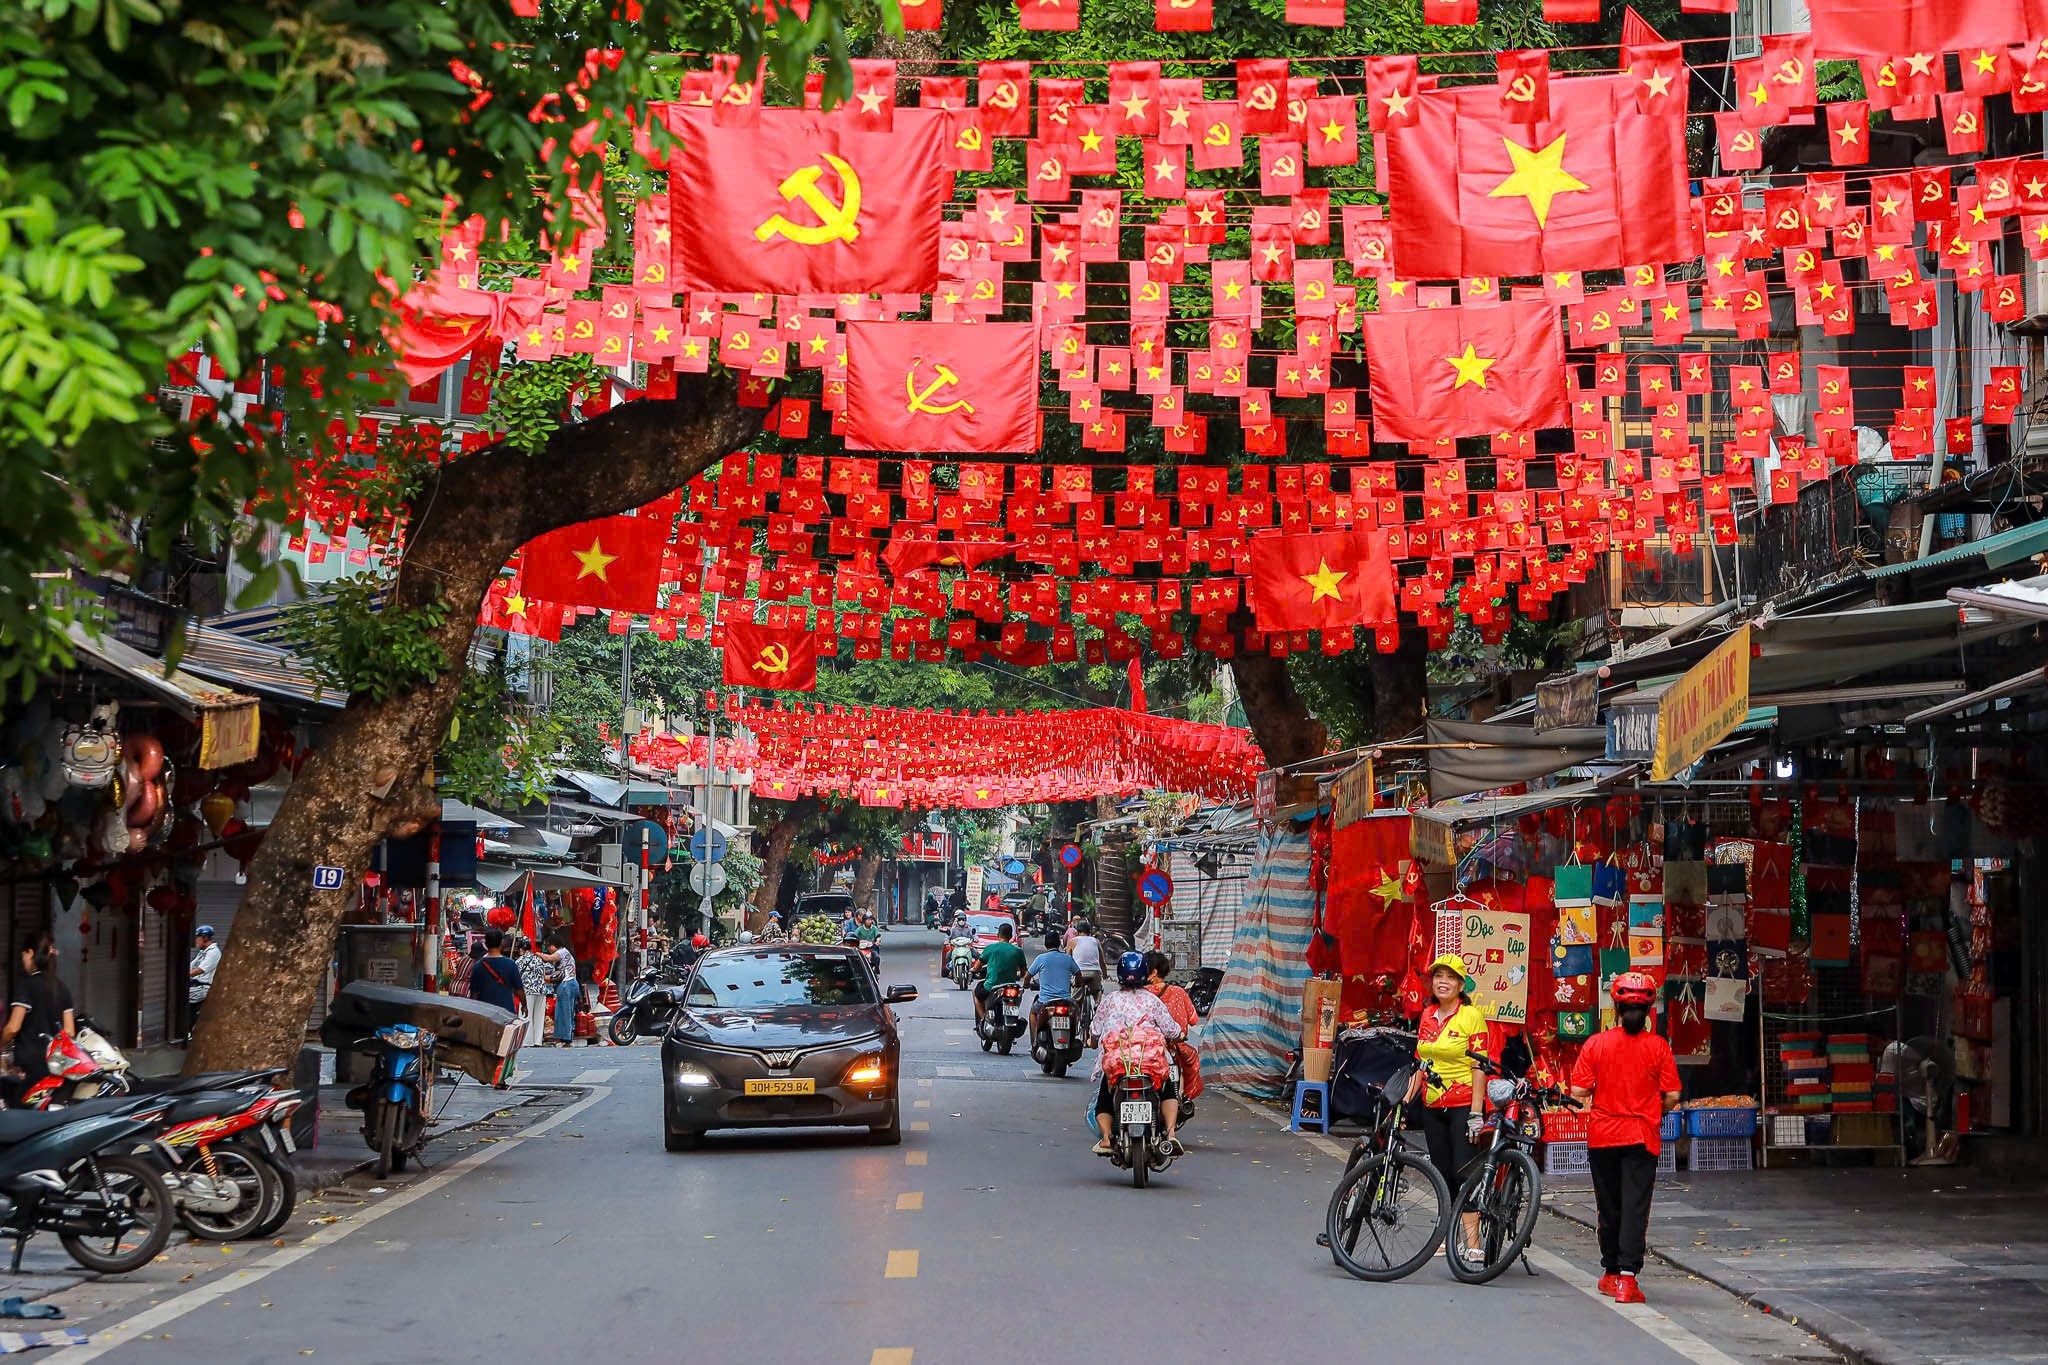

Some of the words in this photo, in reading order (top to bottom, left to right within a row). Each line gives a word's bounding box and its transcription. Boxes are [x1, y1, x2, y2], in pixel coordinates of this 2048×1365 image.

[319, 869, 338, 885] 19
[1465, 914, 1495, 939] Độc
[1507, 937, 1527, 957] lập
[1462, 952, 1487, 976] Tự
[1494, 976, 1508, 991] do
[1497, 1001, 1526, 1019] phúc
[751, 1082, 809, 1093] 30H-529.84
